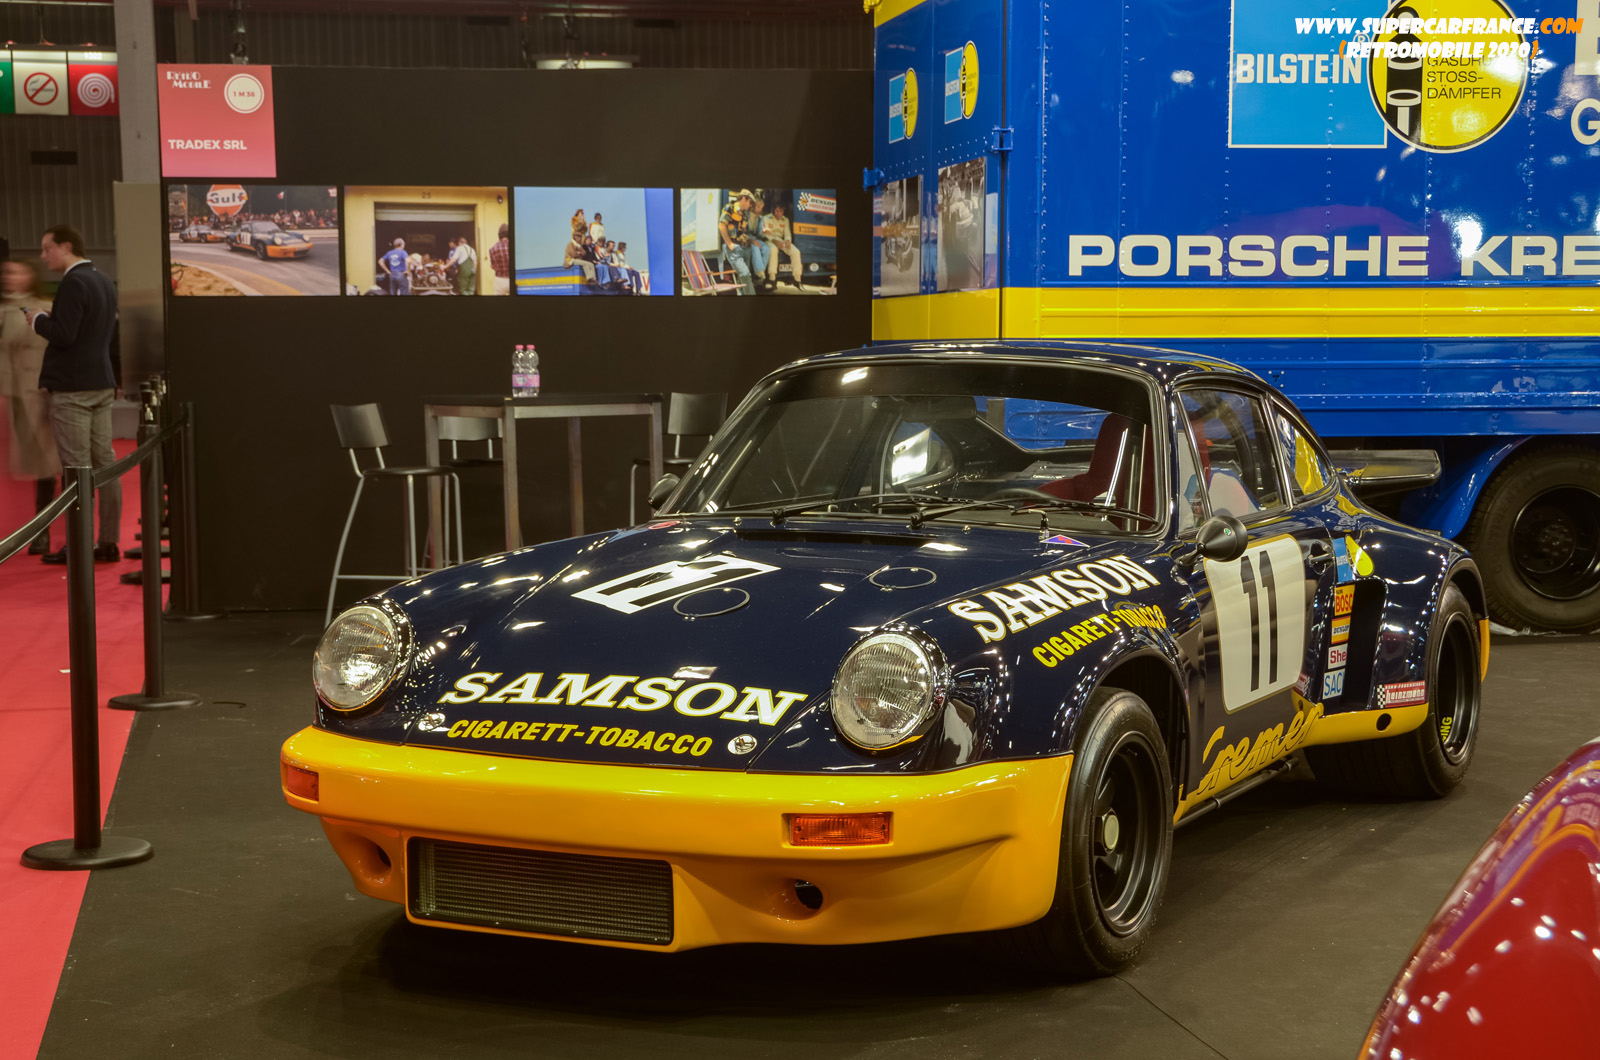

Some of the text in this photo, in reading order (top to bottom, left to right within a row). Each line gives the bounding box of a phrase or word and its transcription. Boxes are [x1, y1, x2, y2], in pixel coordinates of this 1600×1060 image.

[1236, 53, 1362, 84] BILSTEIN
[1427, 71, 1484, 83] STOSS-
[1427, 85, 1502, 99] DÄMPFER
[168, 139, 247, 150] TRADEX SRL
[210, 191, 246, 204] Gulf
[1069, 234, 1600, 277] PORSCHE KRE
[948, 554, 1161, 644] SAMSON
[1240, 550, 1278, 692] 11
[437, 671, 809, 727] SAMSON
[447, 719, 713, 757] CIGARETT-TOBACCO
